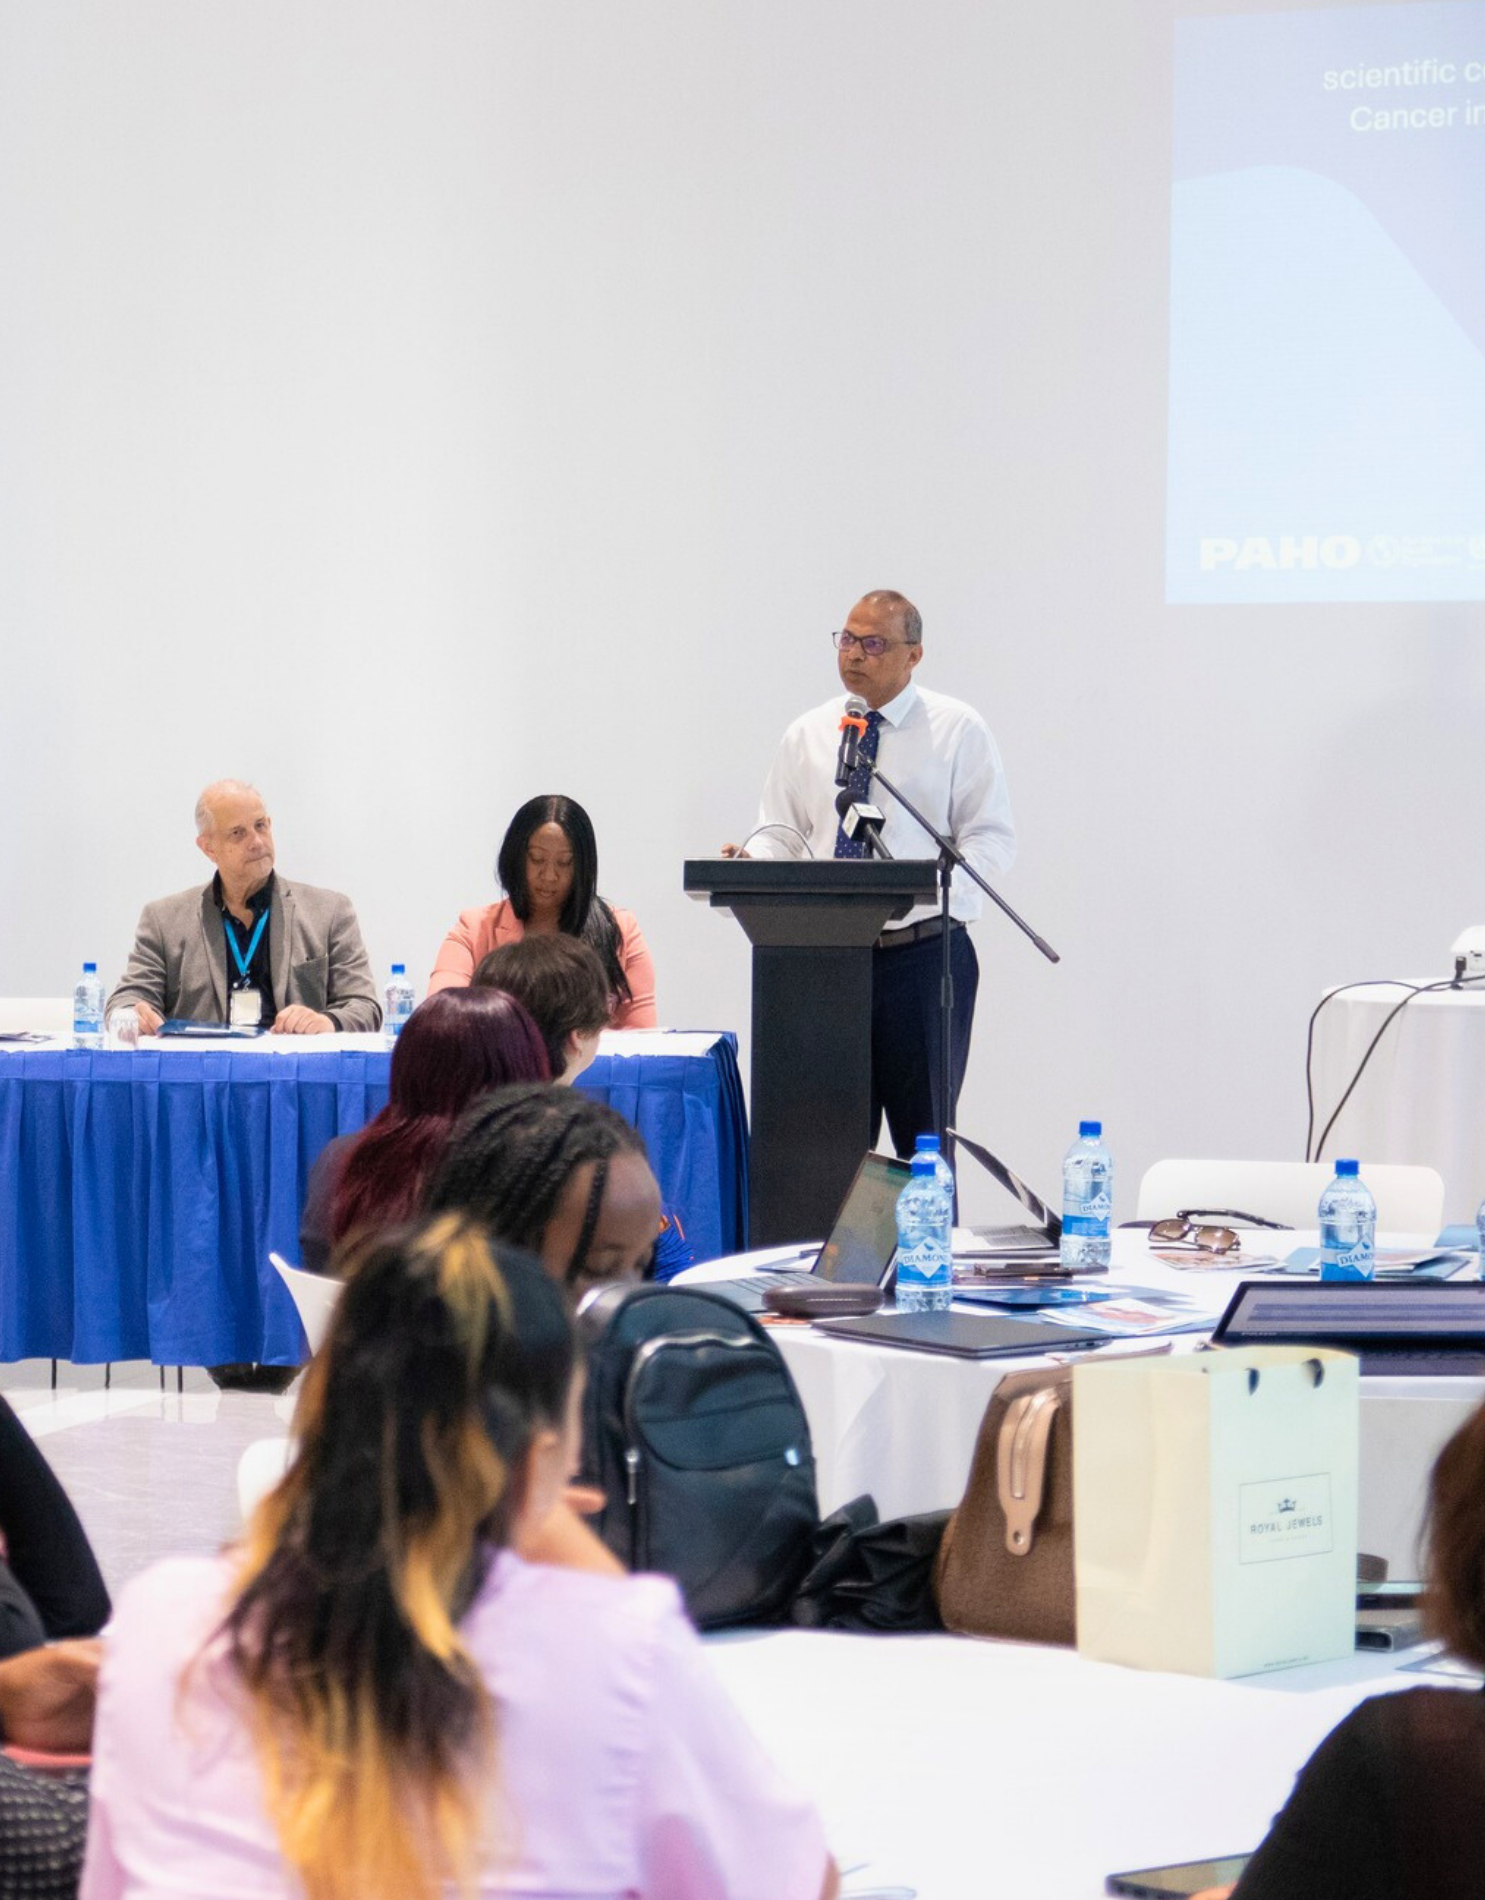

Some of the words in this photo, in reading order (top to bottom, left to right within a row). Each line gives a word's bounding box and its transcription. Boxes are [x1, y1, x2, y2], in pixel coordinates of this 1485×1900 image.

[1323, 57, 1457, 91] scientific
[1465, 61, 1485, 83] c
[1350, 105, 1458, 132] Cancer
[1199, 535, 1362, 571] PAHO
[1250, 1521, 1282, 1535] ROYAL
[1286, 1515, 1323, 1531] JEWELS
